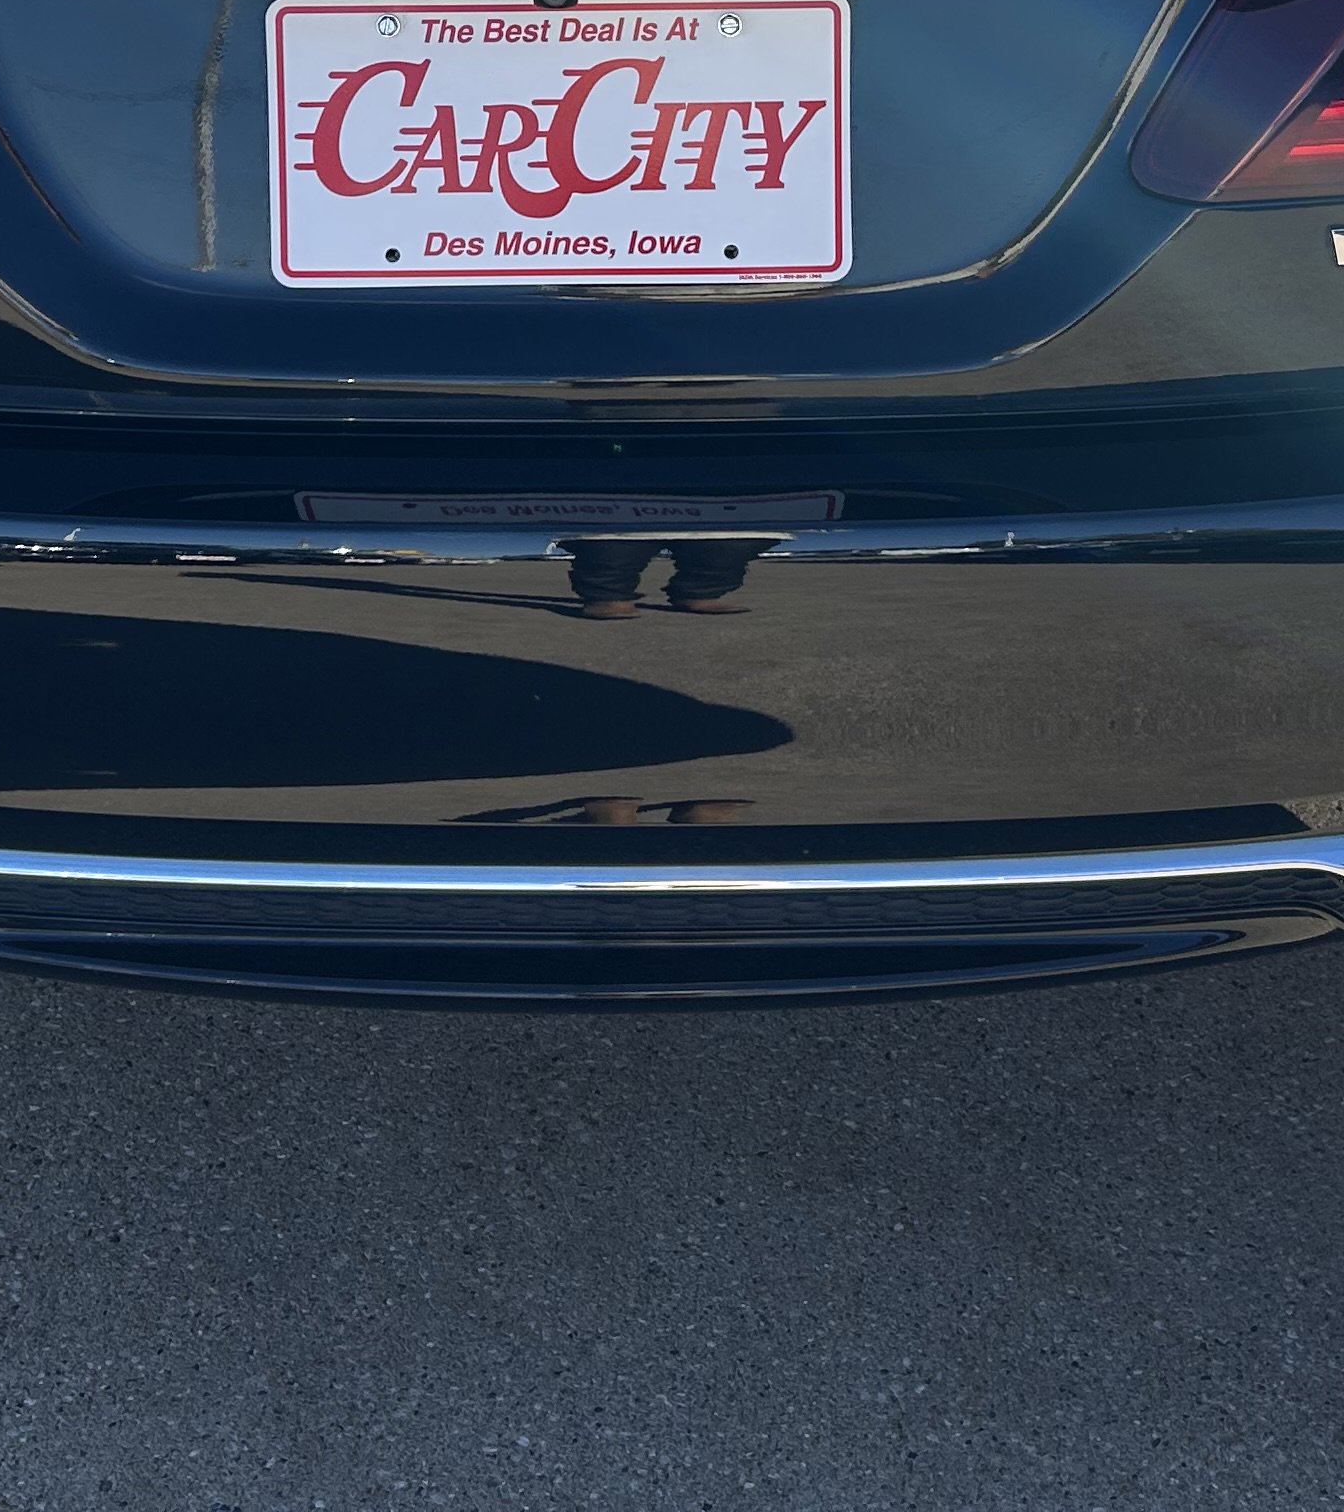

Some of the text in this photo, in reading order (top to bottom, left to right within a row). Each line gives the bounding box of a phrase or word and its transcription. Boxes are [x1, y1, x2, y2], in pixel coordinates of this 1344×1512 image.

[421, 16, 700, 44] The Best Deal Is At
[423, 230, 702, 261] Des Moines, Iowa
